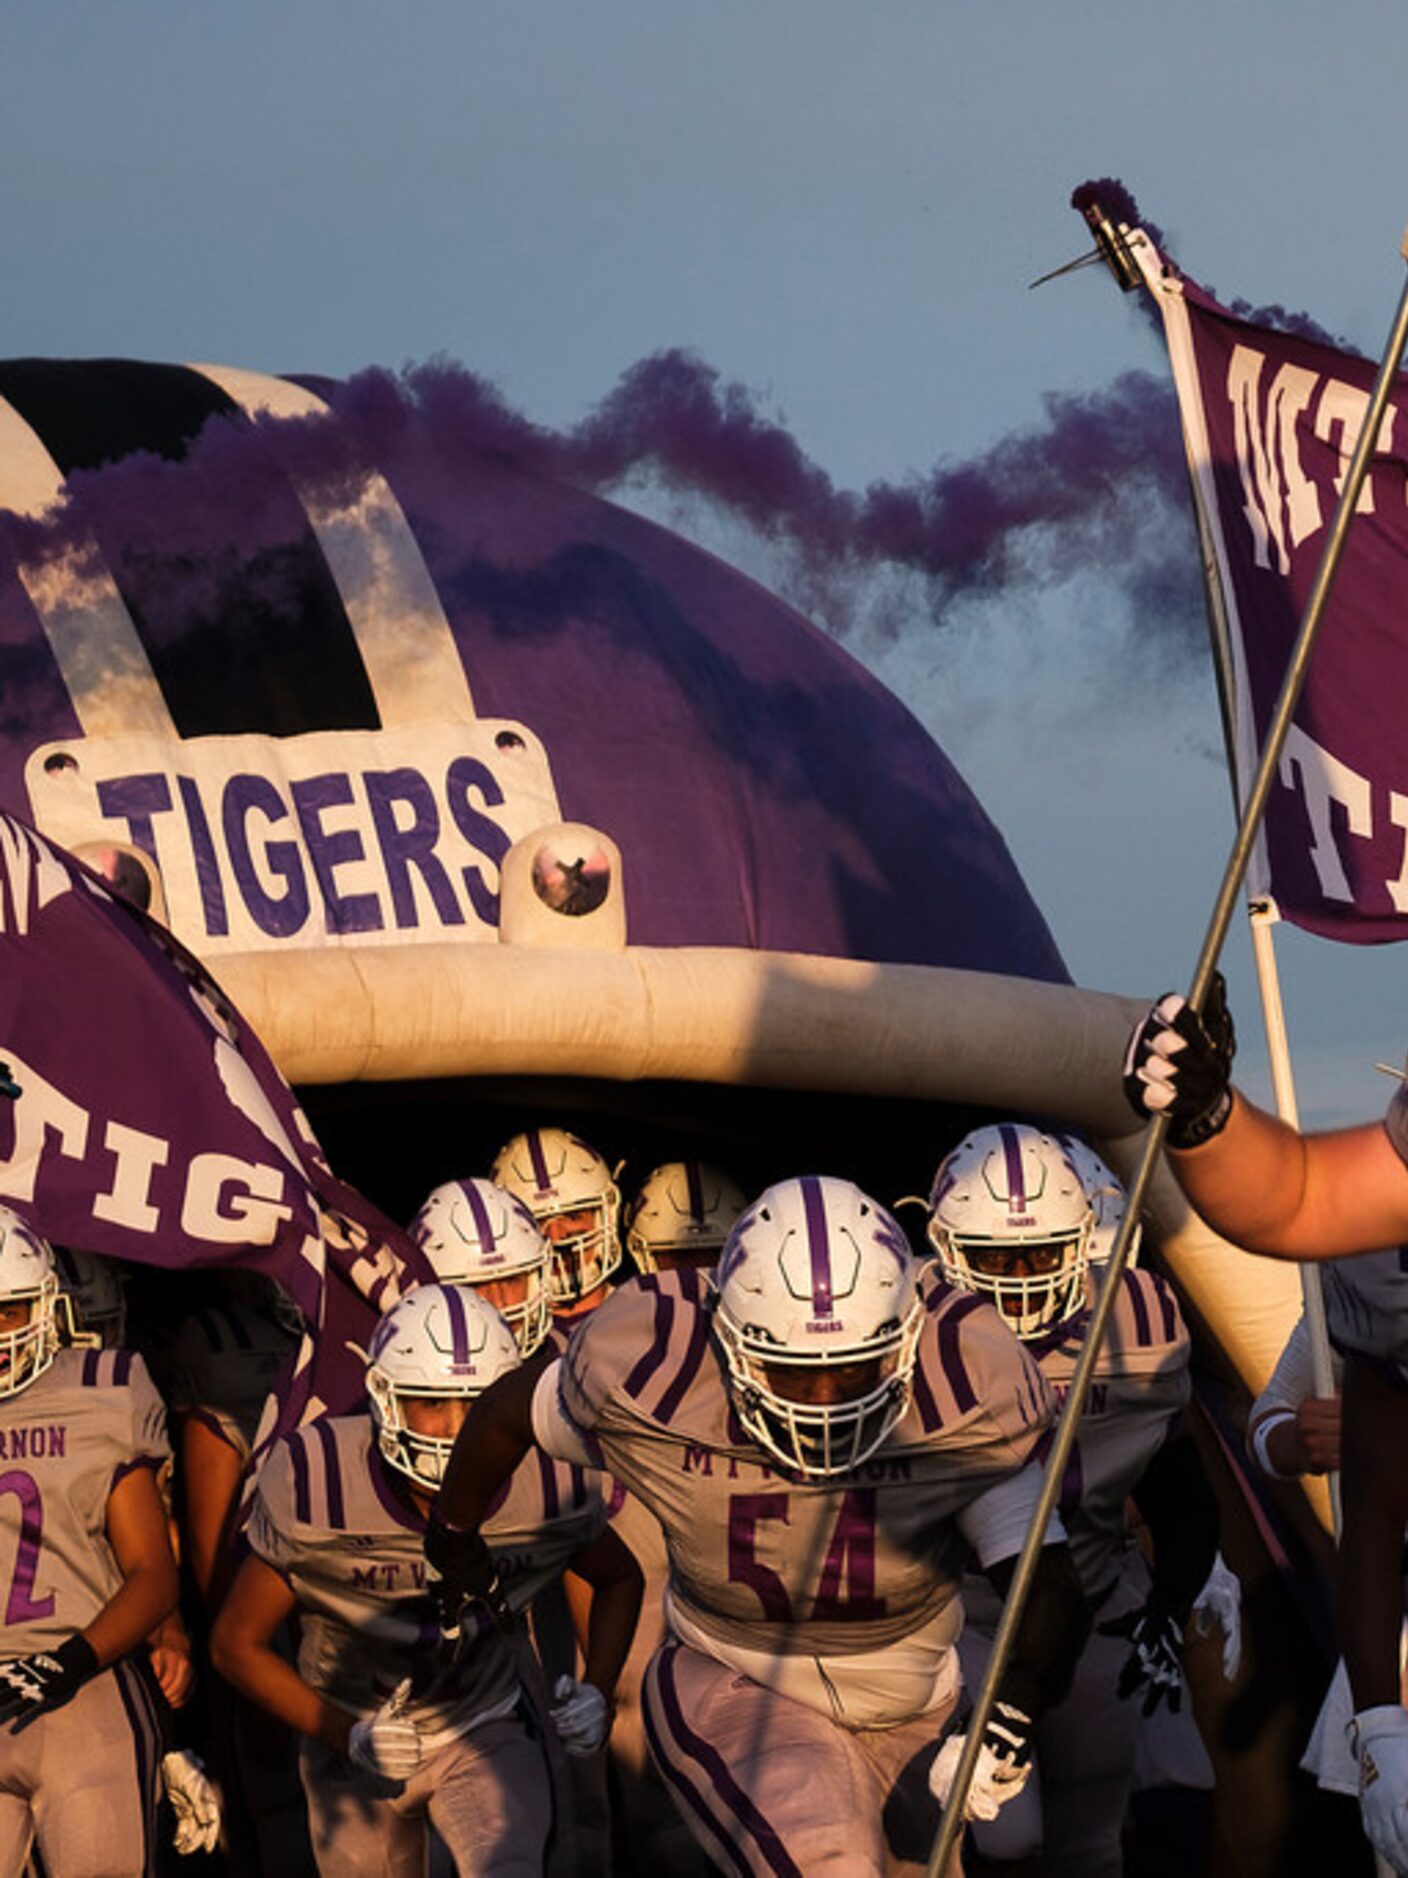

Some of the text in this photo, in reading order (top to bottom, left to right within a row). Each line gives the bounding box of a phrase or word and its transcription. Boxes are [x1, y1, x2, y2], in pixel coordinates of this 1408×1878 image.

[96, 756, 506, 938] TIGERS
[805, 1321, 844, 1335] TIGERS
[352, 1565, 400, 1591] MT
[728, 1487, 888, 1622] 54
